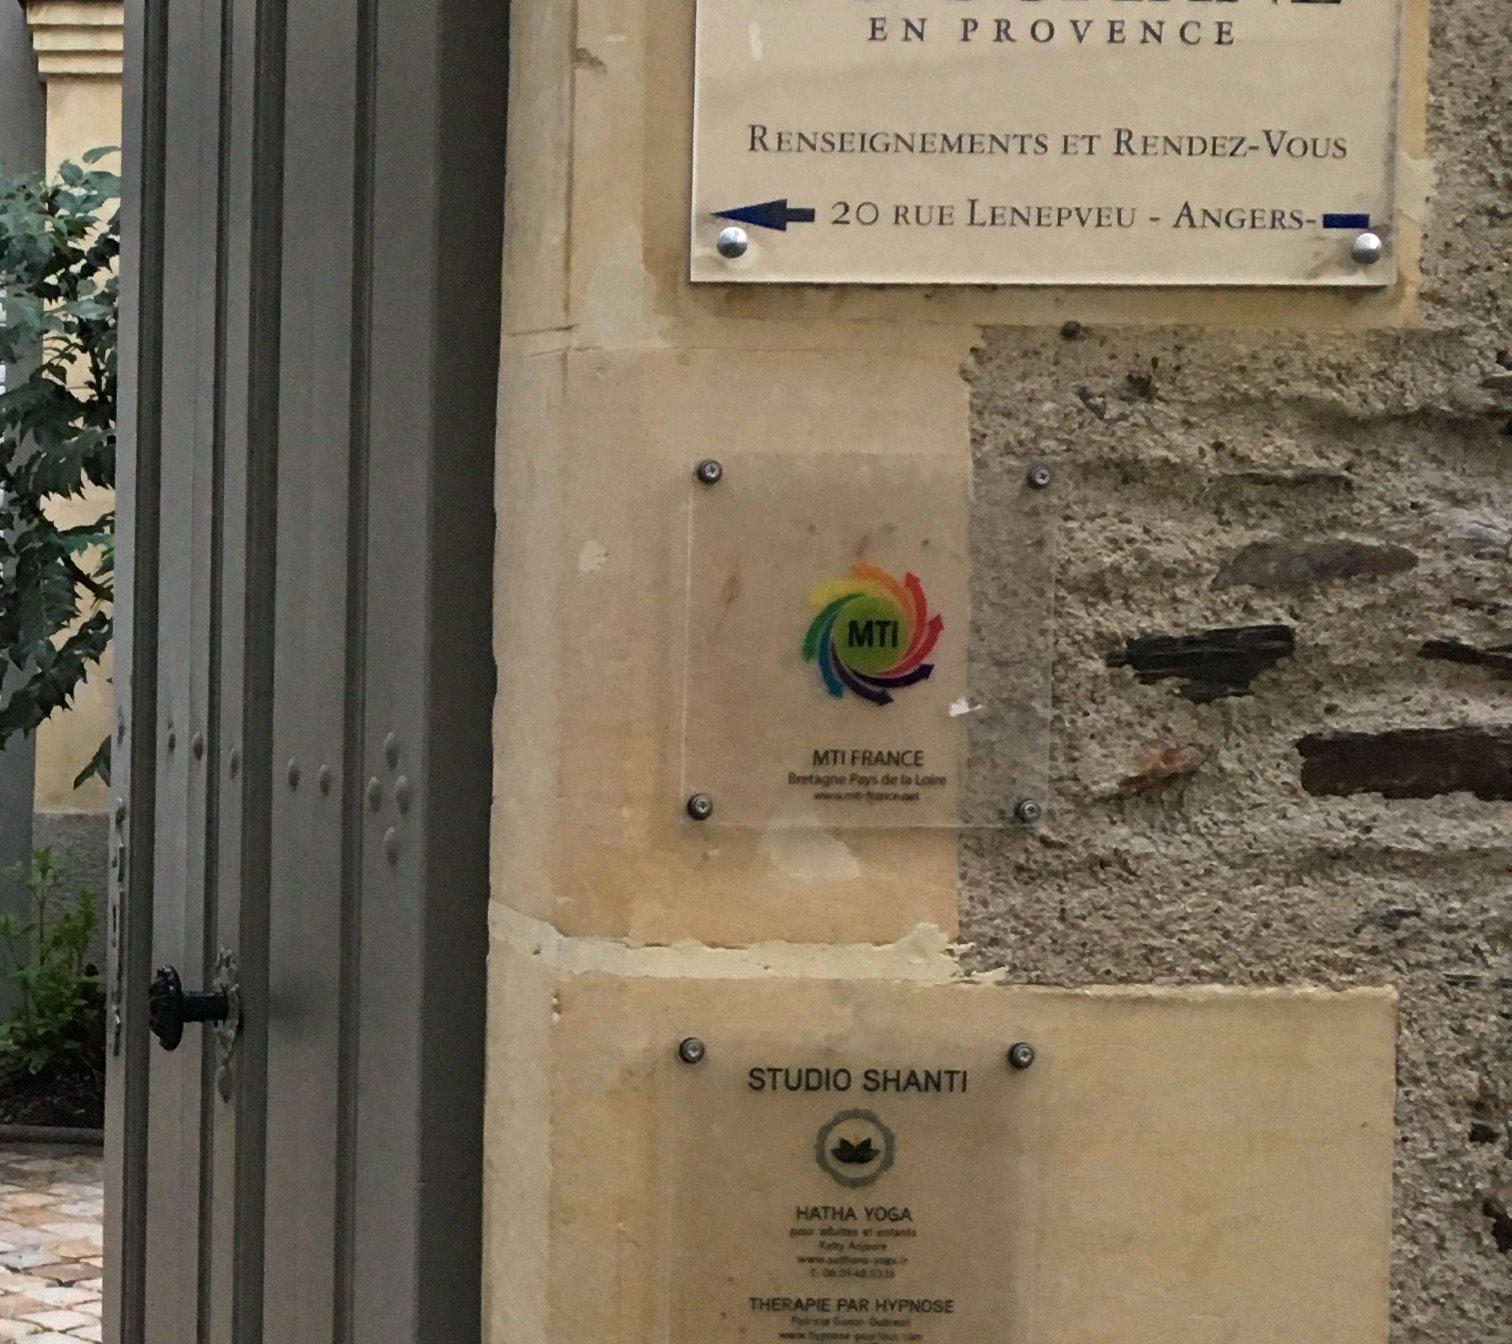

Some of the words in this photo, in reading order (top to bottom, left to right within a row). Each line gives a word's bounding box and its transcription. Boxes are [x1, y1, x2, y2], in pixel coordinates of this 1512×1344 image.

[867, 17, 927, 43] EN
[961, 18, 1237, 46] PROVENCE
[1061, 134, 1101, 156] ET
[831, 202, 880, 226] 20
[893, 205, 955, 227] RUE
[848, 620, 898, 648] MTI
[812, 749, 845, 766] MTI
[851, 750, 924, 767] FRANCE
[788, 771, 847, 787] Bretagne
[849, 773, 878, 787] Pays
[881, 774, 898, 785] de
[900, 774, 912, 785] la
[915, 774, 947, 786] Loire
[748, 1067, 852, 1091] STUDIO
[863, 1069, 967, 1093] SHANTI
[796, 1206, 857, 1221] HATHA
[864, 1206, 912, 1222] YOGA
[749, 1297, 831, 1312] THERAPIE
[837, 1298, 870, 1312] PAR
[875, 1299, 954, 1314] HYPNOSE
